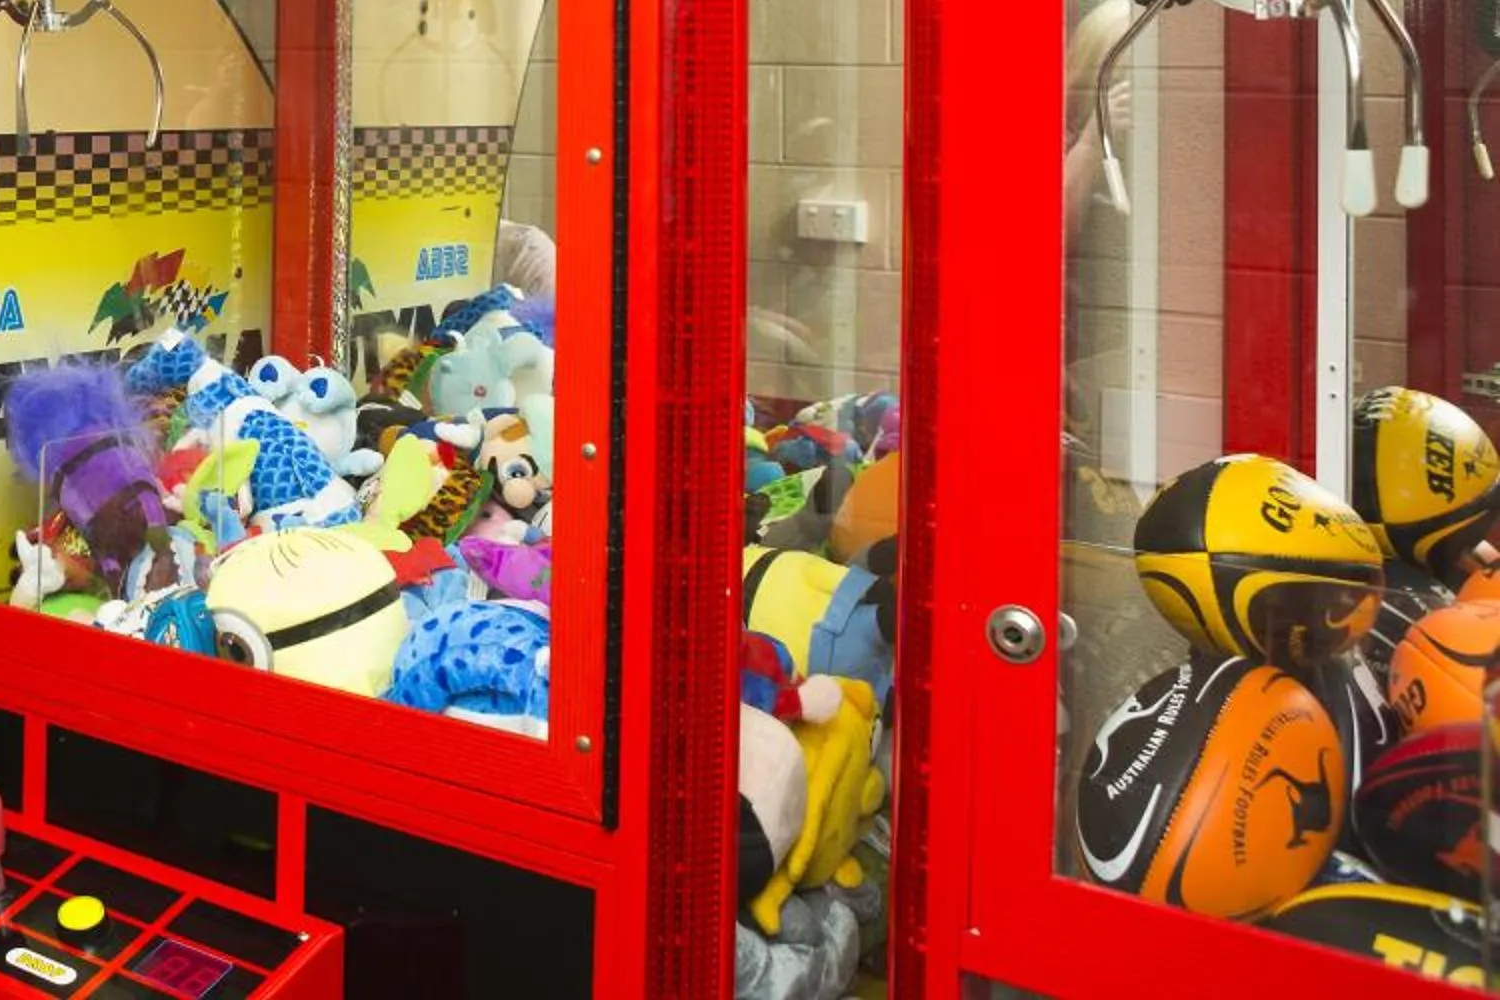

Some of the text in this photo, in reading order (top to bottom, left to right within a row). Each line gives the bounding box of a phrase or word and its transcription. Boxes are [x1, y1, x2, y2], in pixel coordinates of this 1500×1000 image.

[1106, 727, 1170, 800] AUSTRALIAN
[1157, 692, 1186, 726] RULES
[1232, 785, 1255, 868] FOOTBALL
